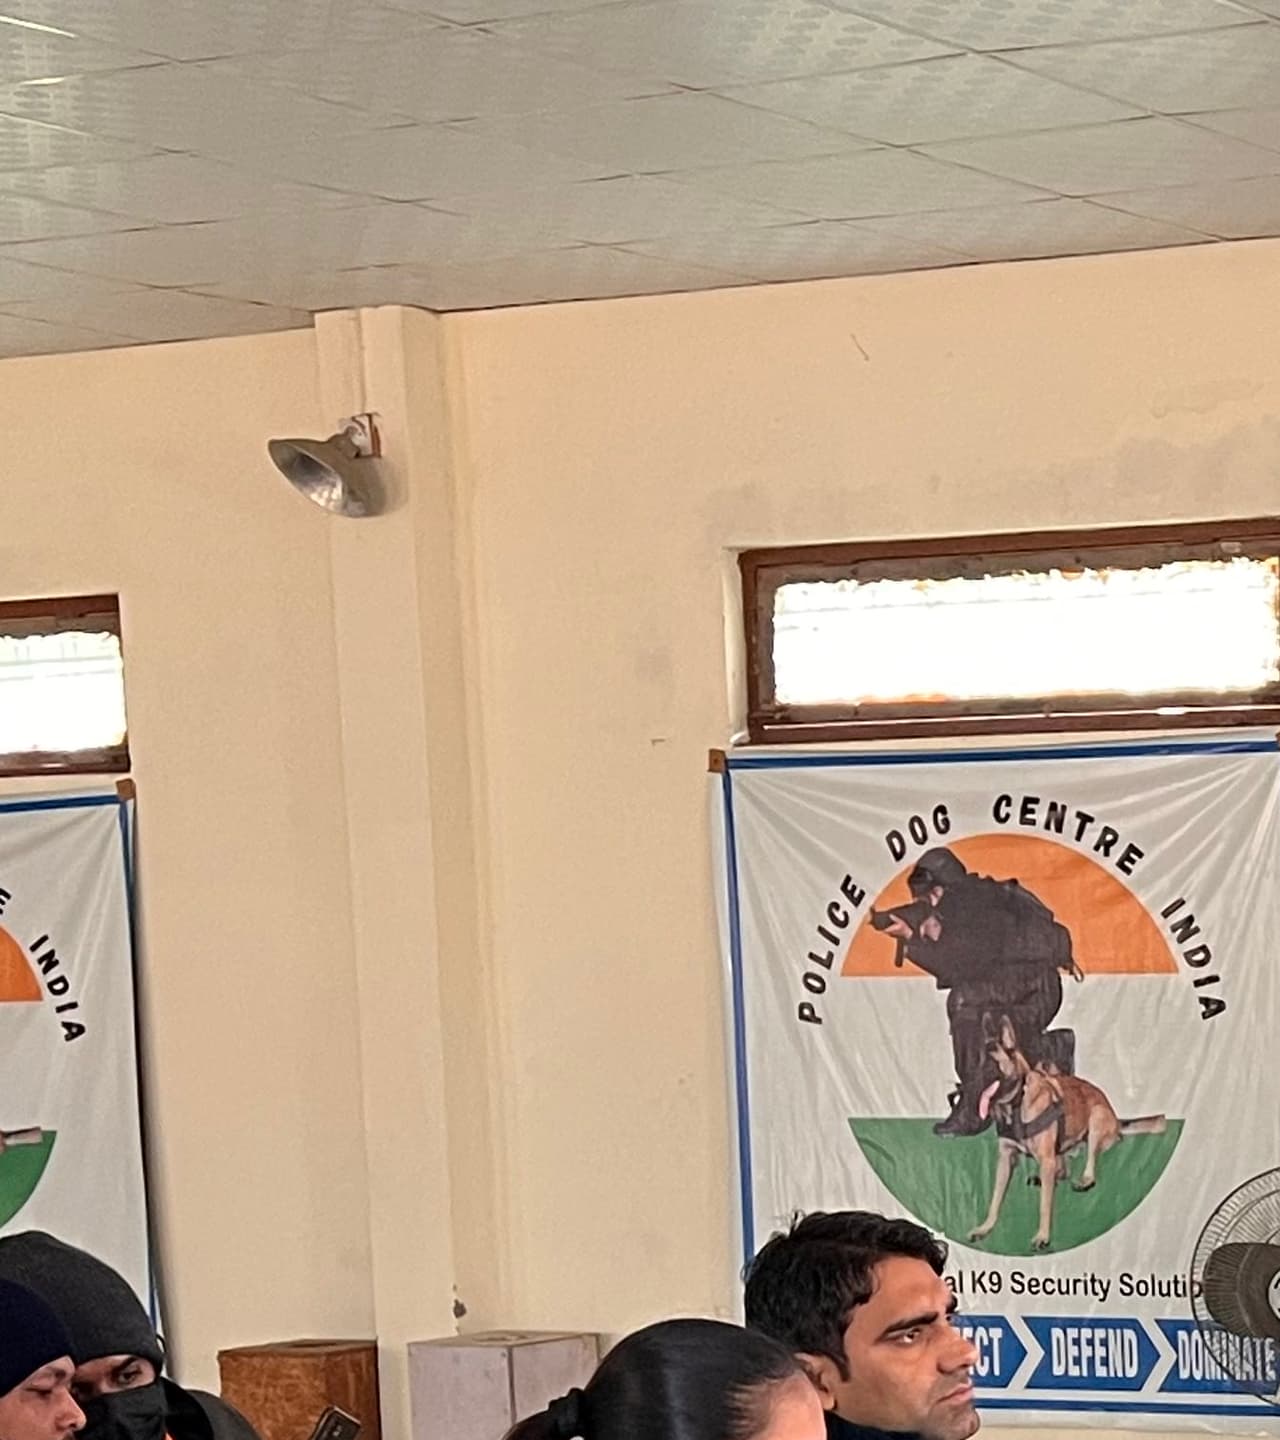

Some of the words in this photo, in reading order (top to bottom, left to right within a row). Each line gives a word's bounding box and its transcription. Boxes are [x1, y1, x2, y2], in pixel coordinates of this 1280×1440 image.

[799, 875, 866, 1024] POLICE
[887, 804, 951, 861] DOG
[992, 794, 1145, 876] CENTRE
[1161, 898, 1226, 1020] INDIA
[29, 934, 86, 1042] INDIA
[971, 1271, 1002, 1294] K9
[1010, 1271, 1111, 1302] Security
[1050, 1326, 1138, 1378] DEFEND
